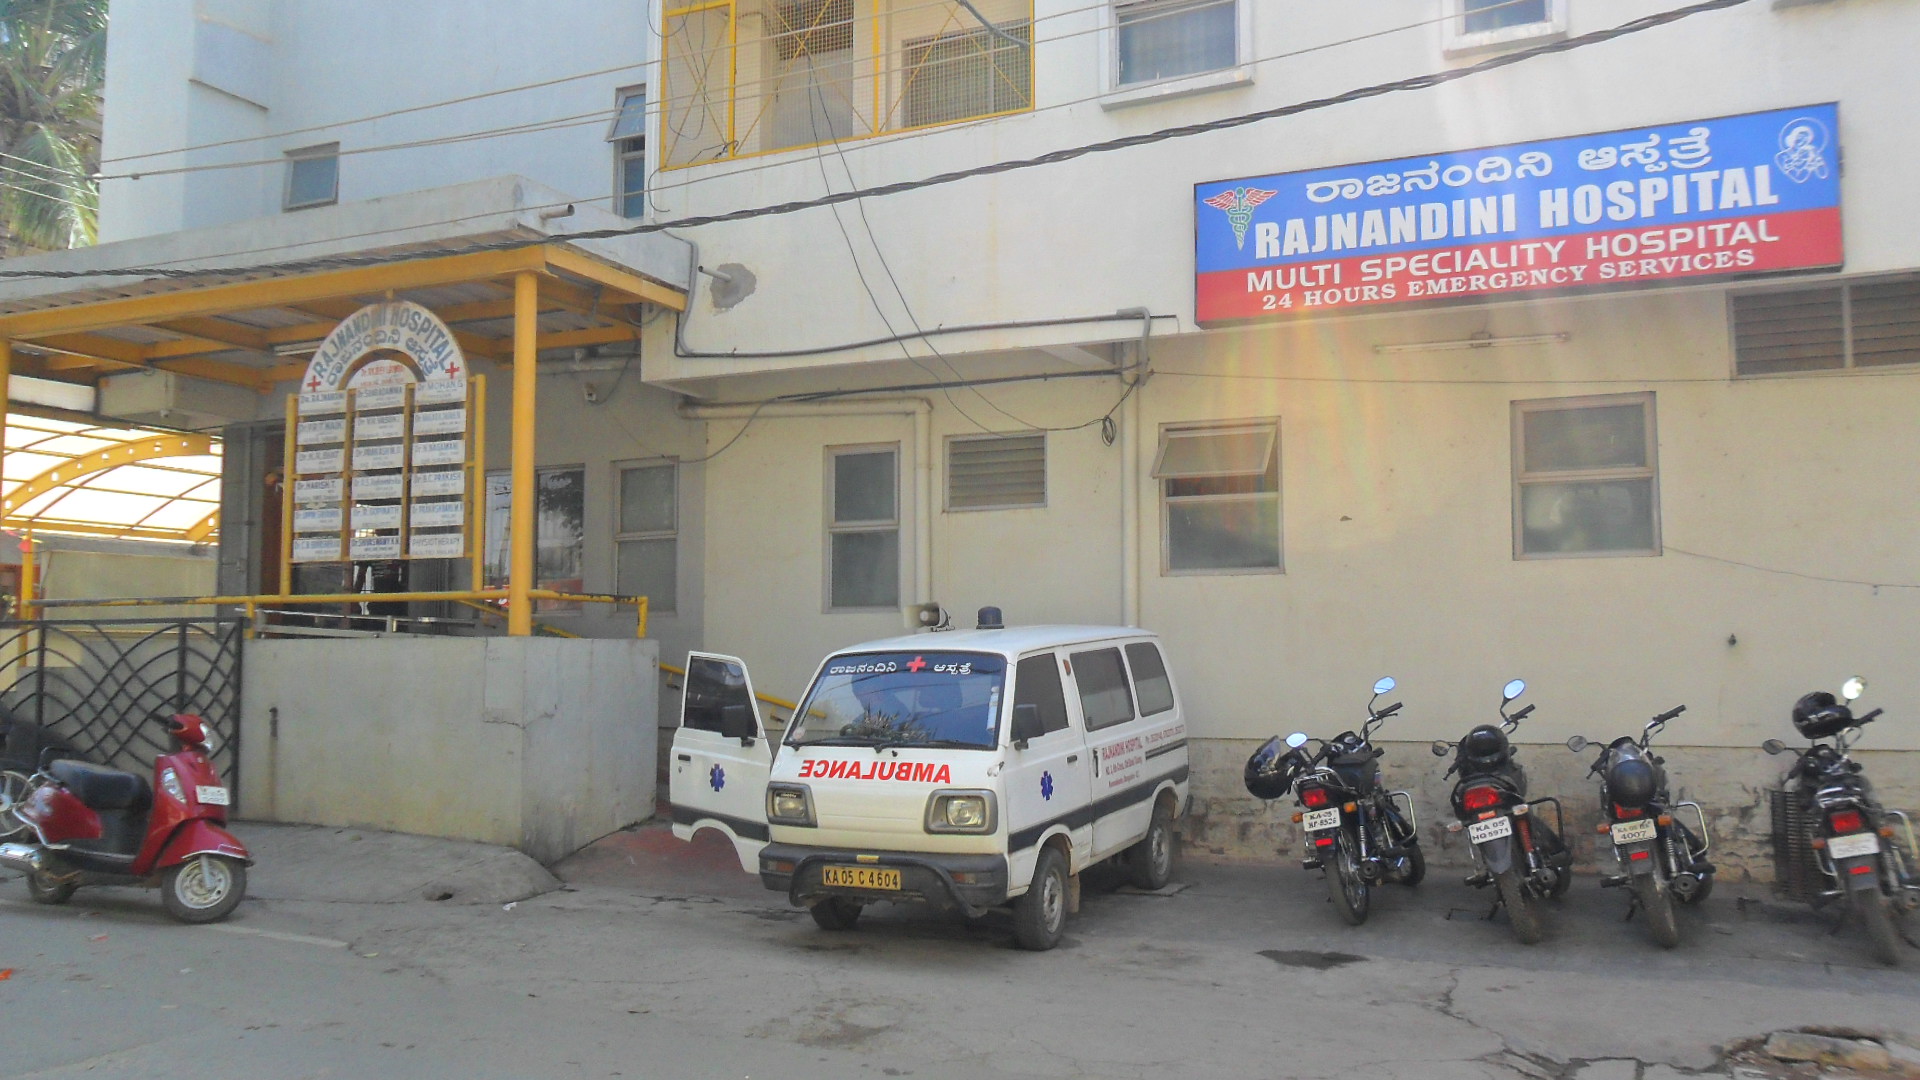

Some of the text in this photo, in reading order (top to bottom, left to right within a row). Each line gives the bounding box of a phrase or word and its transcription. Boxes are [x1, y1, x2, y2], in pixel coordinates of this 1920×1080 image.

[1306, 126, 1712, 203] ರಾಜನಂದಿನಿ ಆಸ್ಪತ್ರೆ
[1255, 164, 1779, 259] RAJNANDINI HOSPITAL
[1247, 219, 1779, 293] MULTI SPECIALITY HOSPITAL
[1263, 250, 1755, 310] 24 HOURS EMERGENCY SERVICES
[391, 306, 454, 373] HOSPITAL
[829, 661, 971, 675] ರಾಜನಂದಿನಿ ಆಸ್ಪತ್ರೆ
[1475, 824, 1490, 832] KA
[1620, 830, 1647, 840] 4007
[868, 871, 898, 888] 4604
